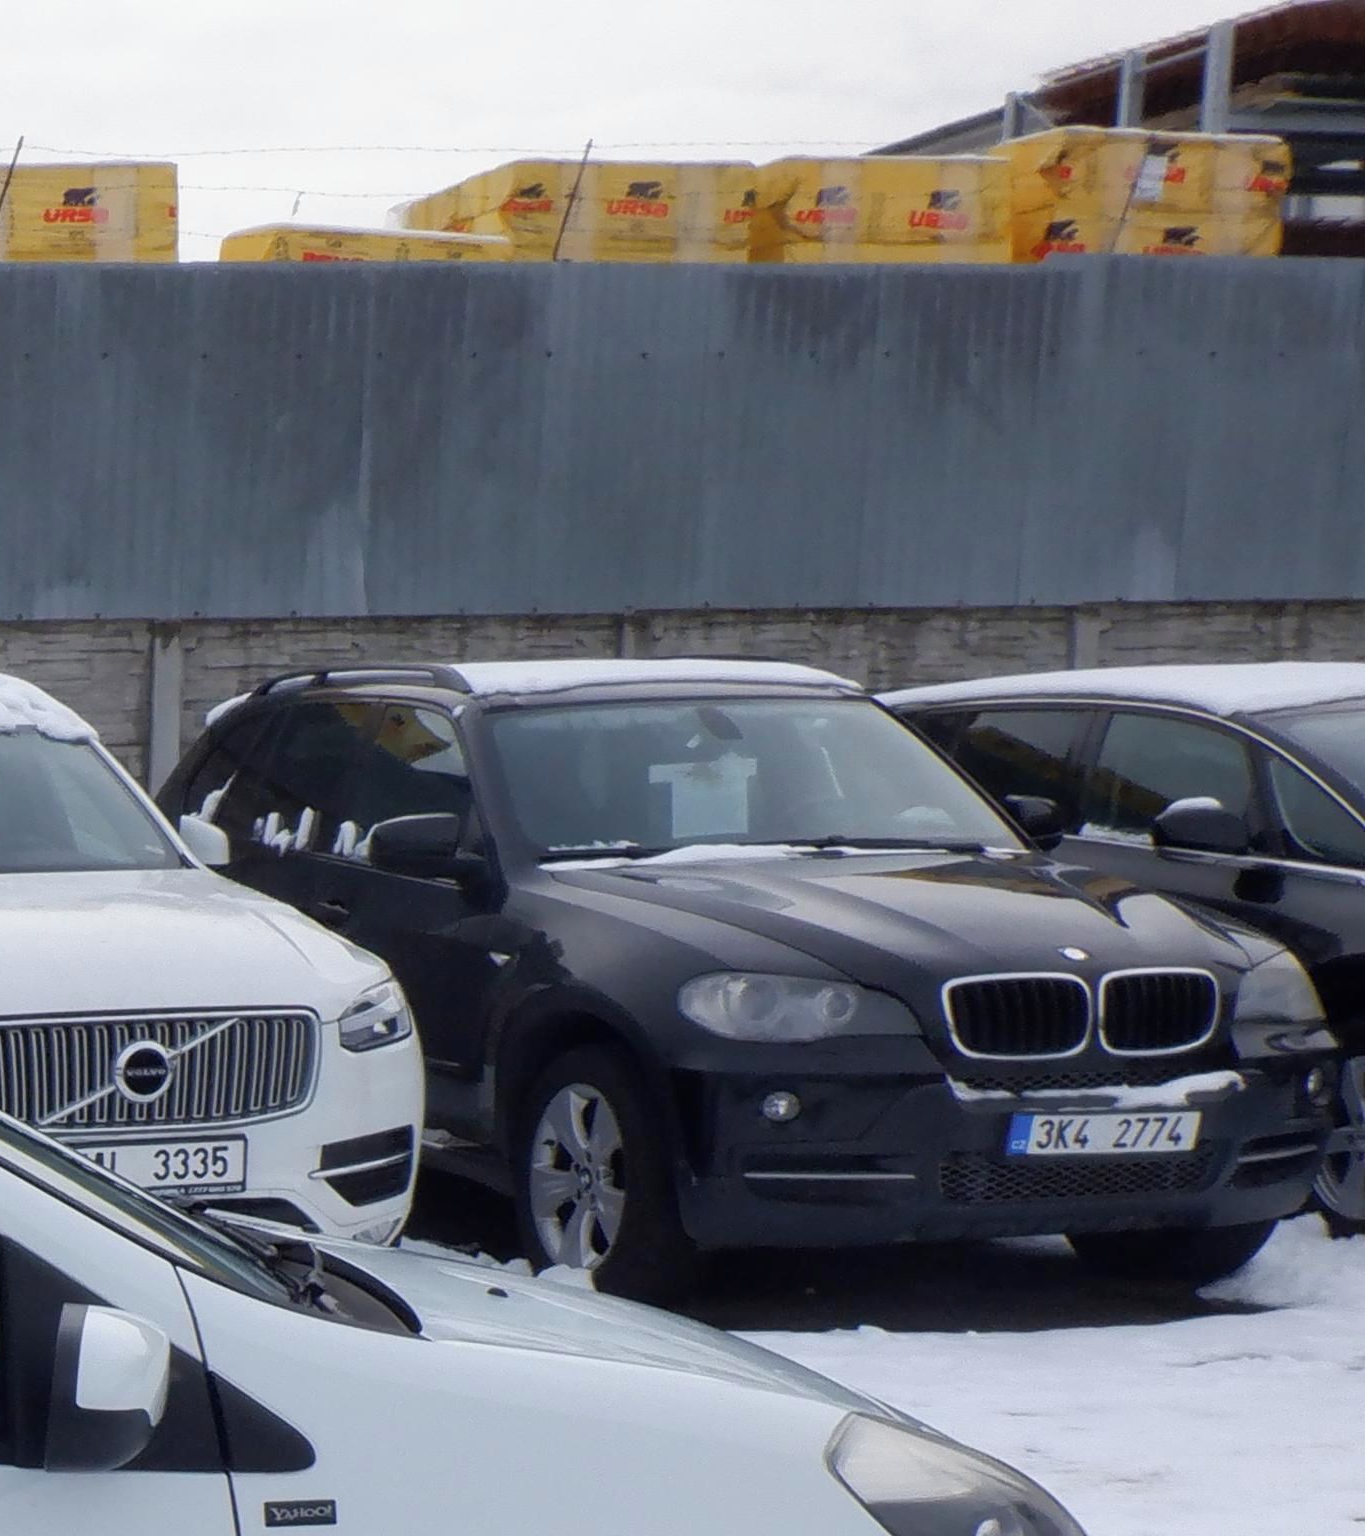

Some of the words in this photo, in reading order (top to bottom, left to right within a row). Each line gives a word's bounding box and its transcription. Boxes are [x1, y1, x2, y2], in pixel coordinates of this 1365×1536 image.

[126, 1068, 167, 1077] VOLVO
[1036, 1118, 1090, 1150] 3K4
[1112, 1116, 1183, 1149] 2774
[153, 1146, 229, 1181] 3335
